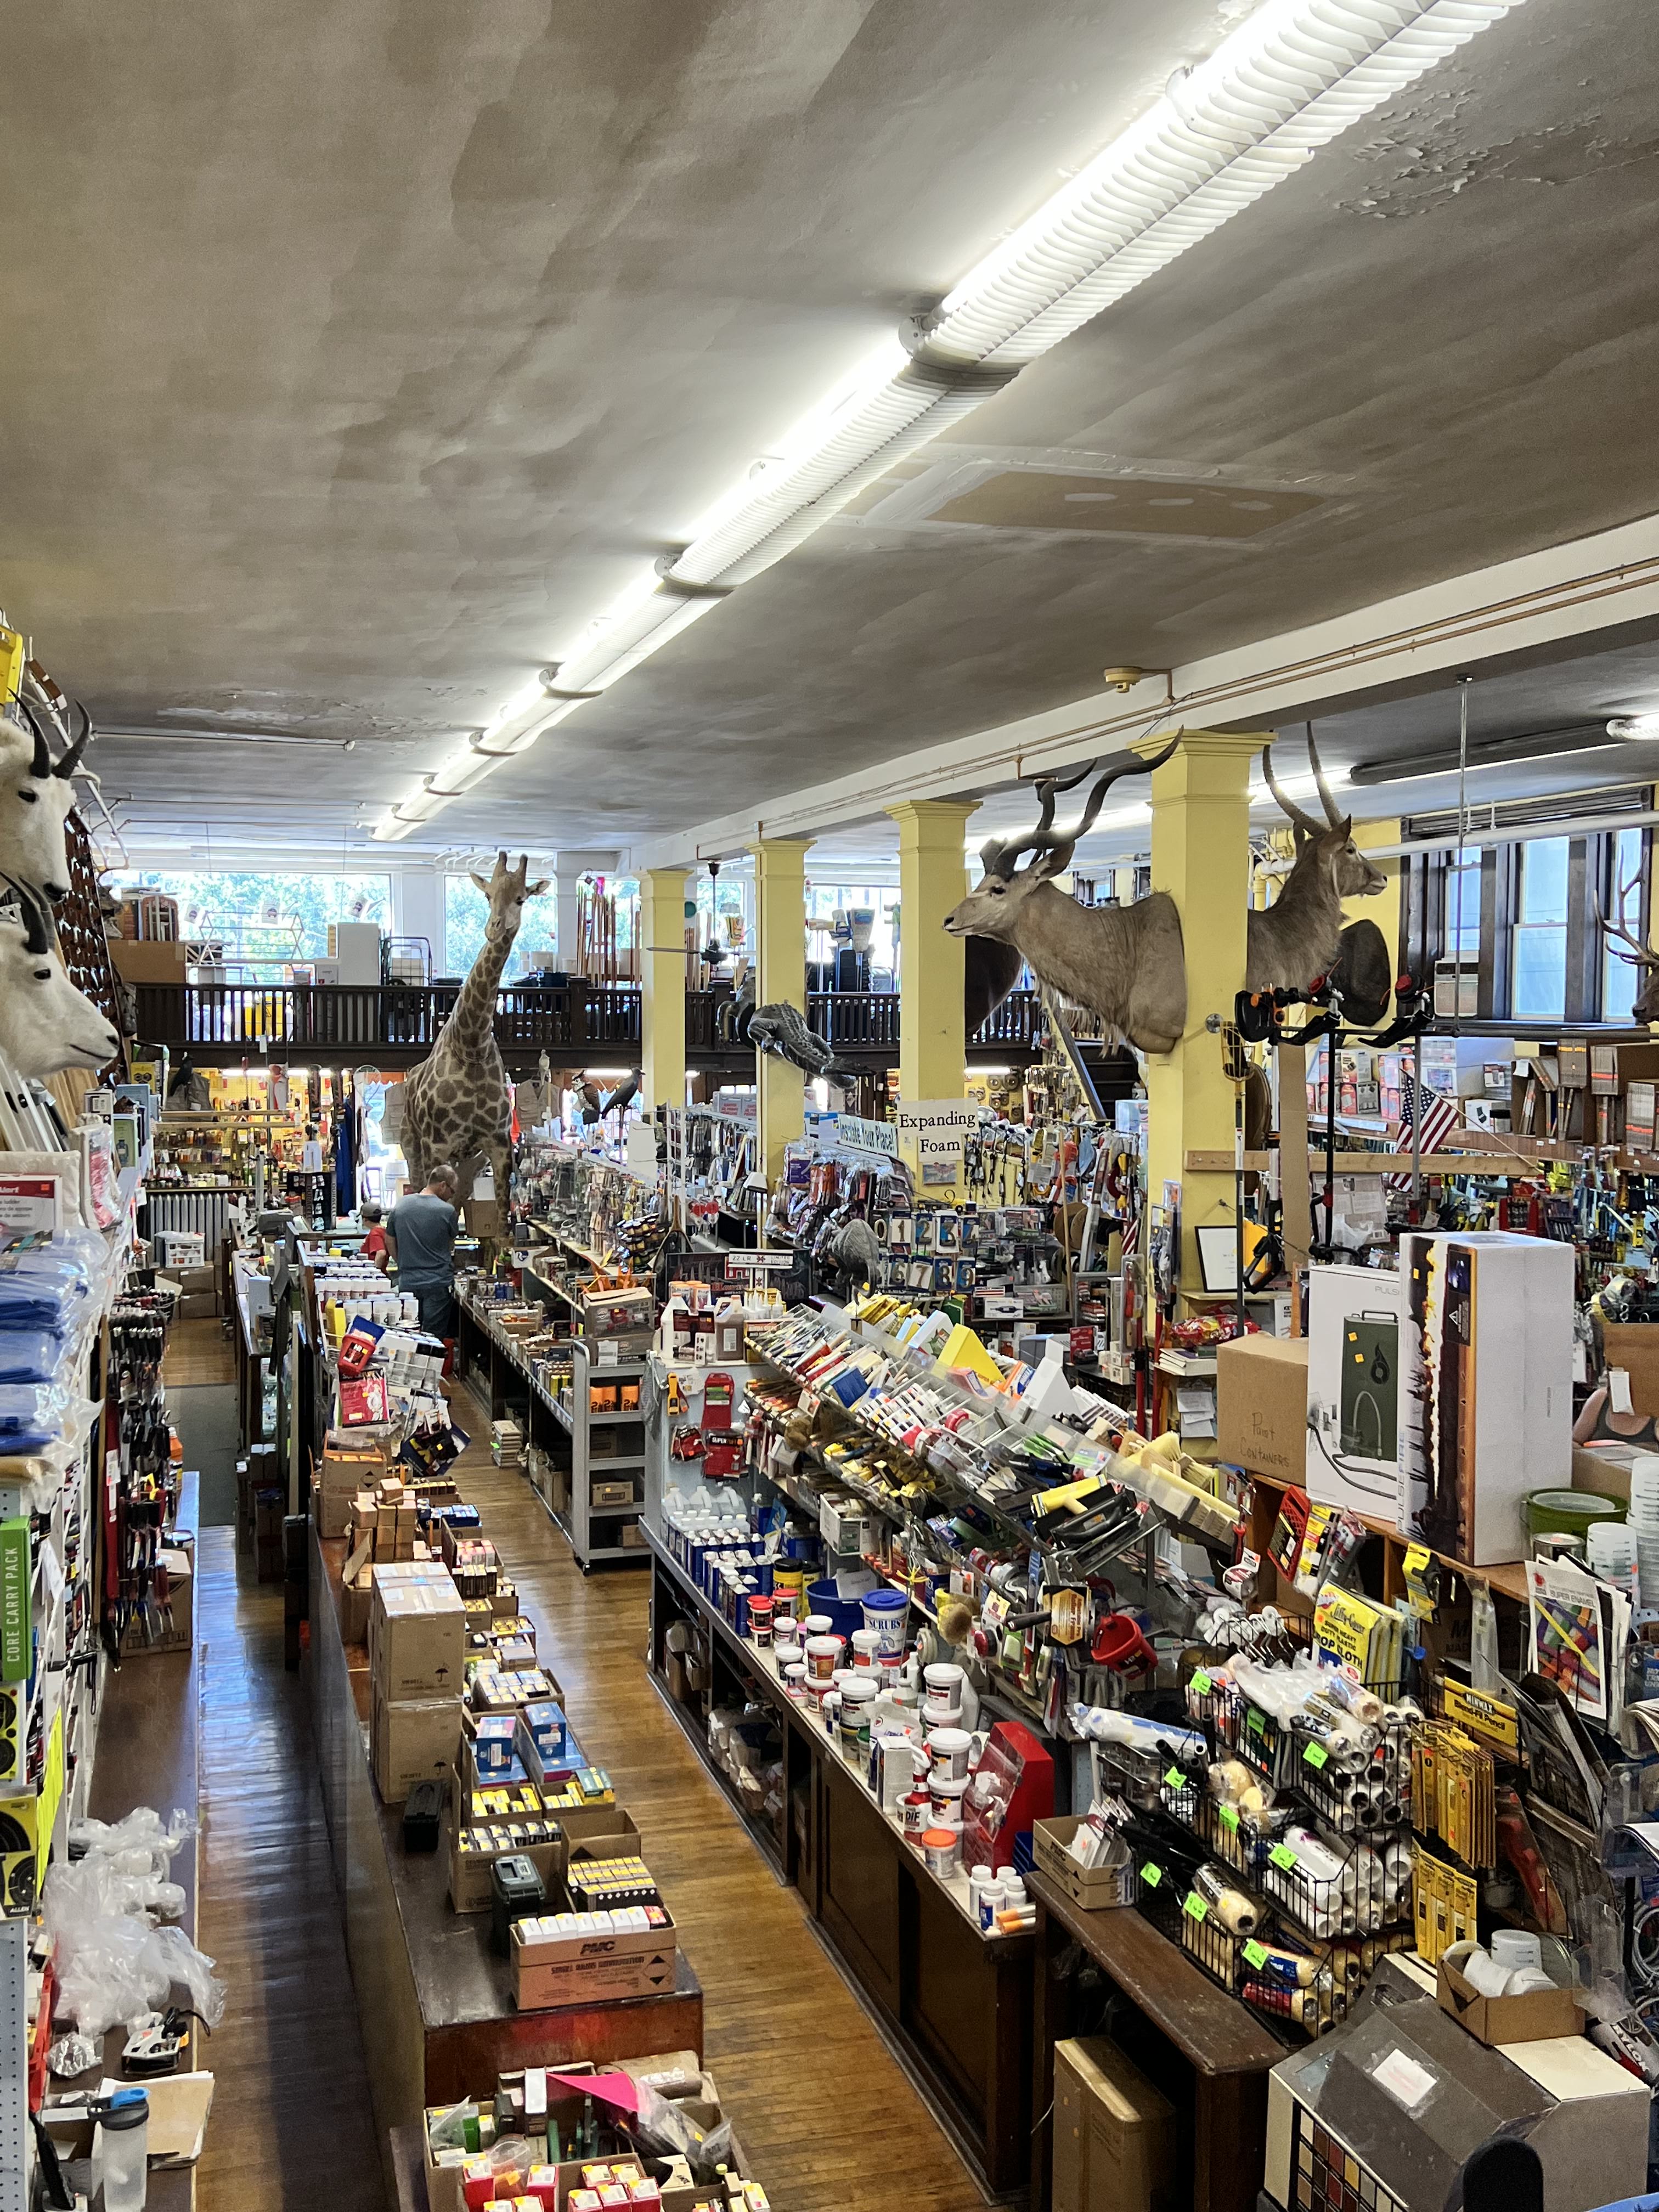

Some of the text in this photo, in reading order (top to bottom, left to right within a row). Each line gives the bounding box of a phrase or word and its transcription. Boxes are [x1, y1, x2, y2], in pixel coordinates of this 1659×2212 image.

[899, 1110, 975, 1131] Expanding
[862, 1124, 874, 1147] Your
[875, 1126, 894, 1153] Place!
[920, 1139, 961, 1153] Foam
[898, 1220, 905, 1242] 1
[918, 1220, 932, 1245] 2
[941, 1222, 956, 1246] 3
[966, 1223, 980, 1244] 4
[891, 1262, 905, 1283] 6
[916, 1265, 929, 1288] 7
[939, 1265, 950, 1285] 8
[961, 1268, 973, 1288] 9
[1374, 1285, 1400, 1295] PULS
[5, 1548, 20, 1662] CORE CARRY PACK
[869, 1619, 901, 1630] SCRUBS
[1336, 1645, 1363, 1669] CLOTH
[1466, 1692, 1493, 1714] MINWAX
[1484, 1713, 1506, 1731] Pencil
[906, 1812, 920, 1822] DIF
[580, 1940, 615, 1955] PMC
